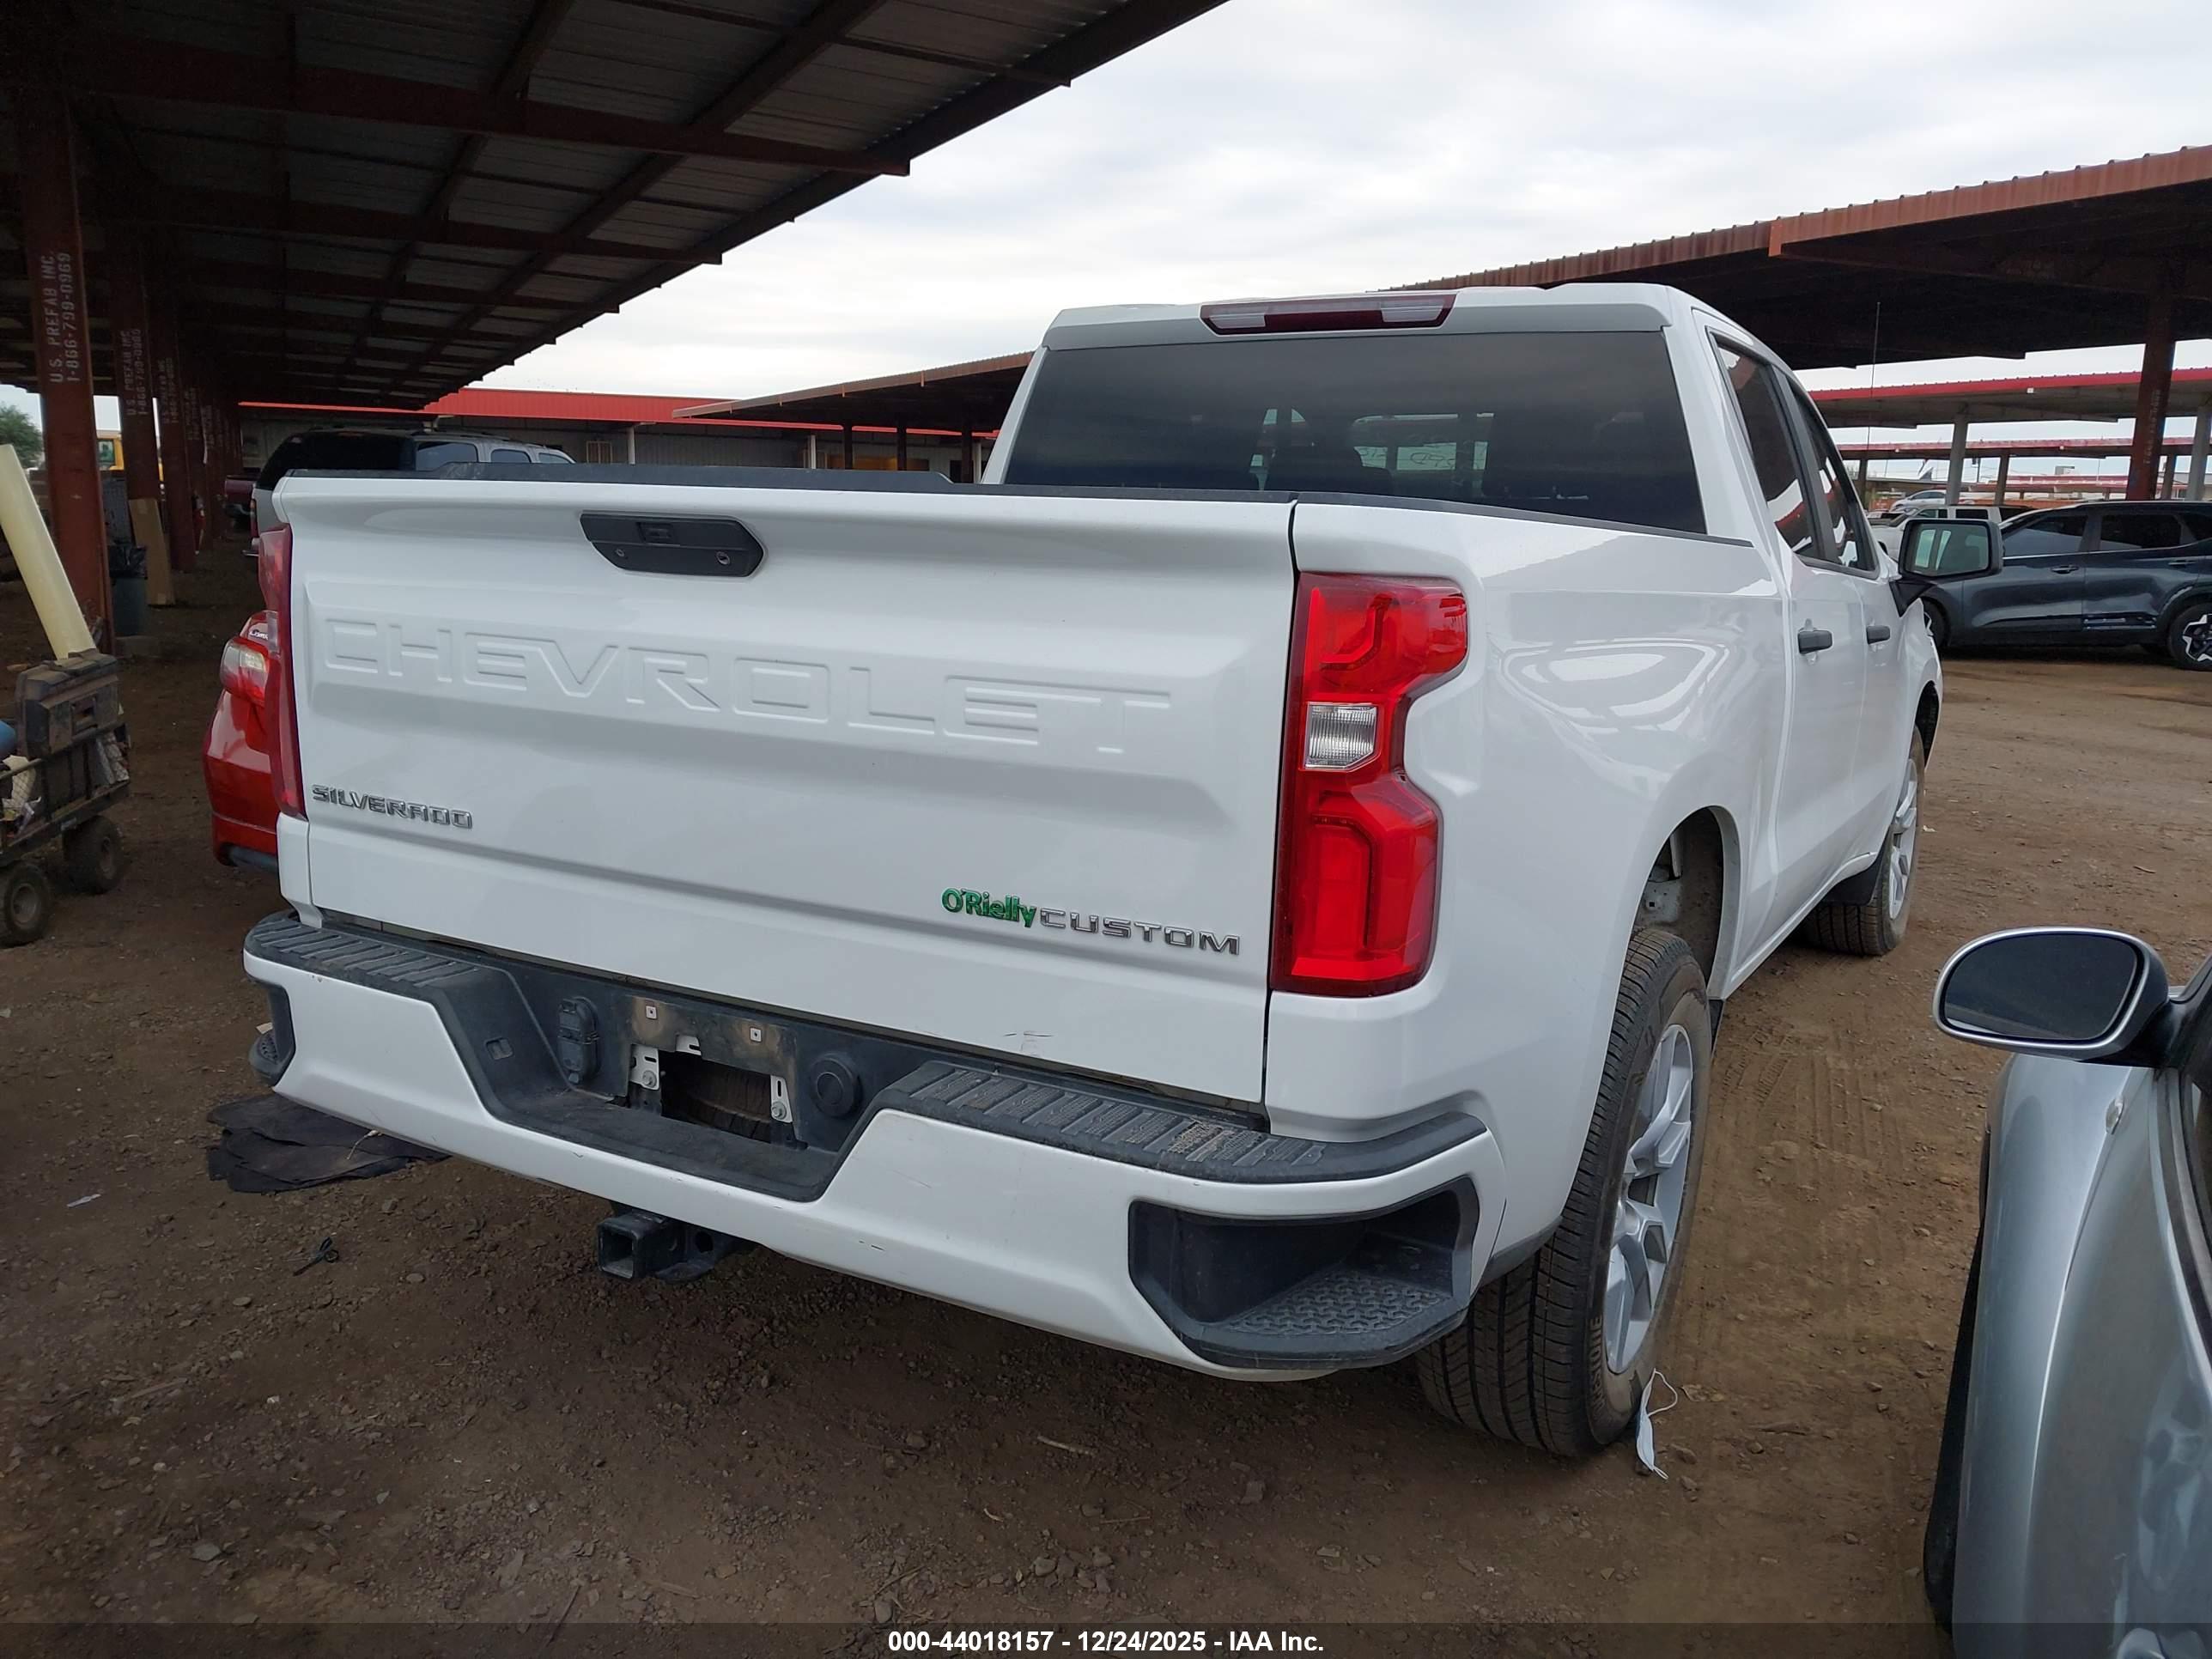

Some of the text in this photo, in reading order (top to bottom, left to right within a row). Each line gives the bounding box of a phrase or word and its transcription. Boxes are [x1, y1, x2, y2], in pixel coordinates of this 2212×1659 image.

[43, 287, 61, 346] PREFAB
[57, 252, 81, 383] 1-866-799-0969
[49, 354, 64, 383] U.S.
[323, 615, 1172, 756] CHEVROLET
[312, 783, 472, 830] SILVERADO
[941, 887, 1037, 928] O'Rielly
[1039, 906, 1240, 957] CUSTOM
